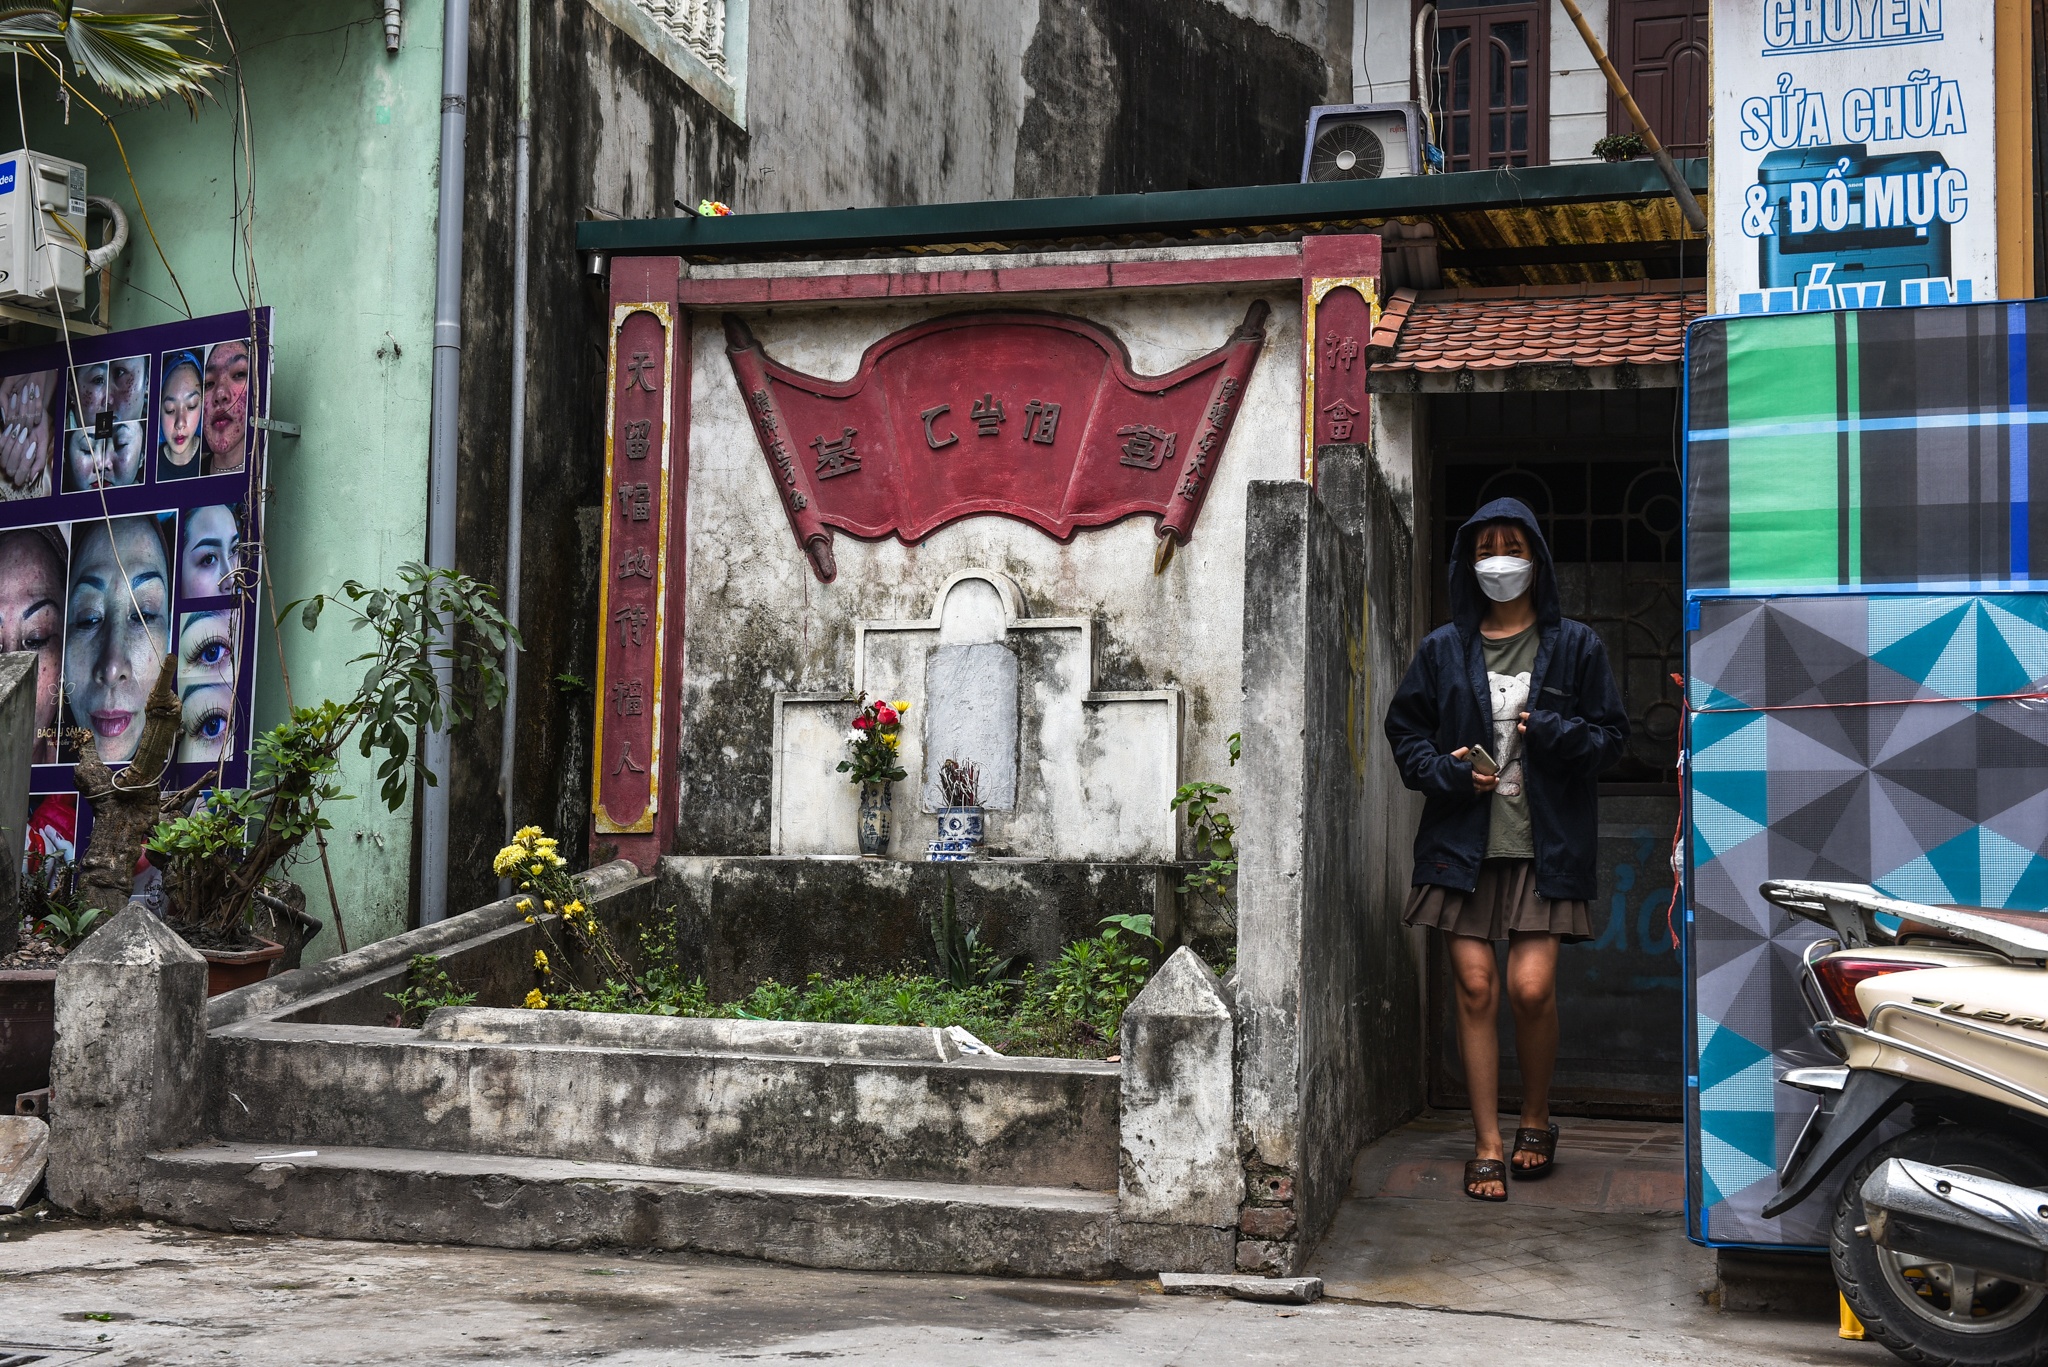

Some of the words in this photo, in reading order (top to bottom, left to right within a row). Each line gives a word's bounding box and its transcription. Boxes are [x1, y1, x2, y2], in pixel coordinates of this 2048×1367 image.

[1740, 72, 1831, 151] SỬA
[1842, 68, 1967, 143] CHỮA
[0, 174, 14, 186] dea
[1741, 180, 1777, 238] &
[1789, 157, 1850, 236] ĐỔ
[1862, 165, 1968, 238] MỰC
[1939, 1001, 2048, 1033] LEA
